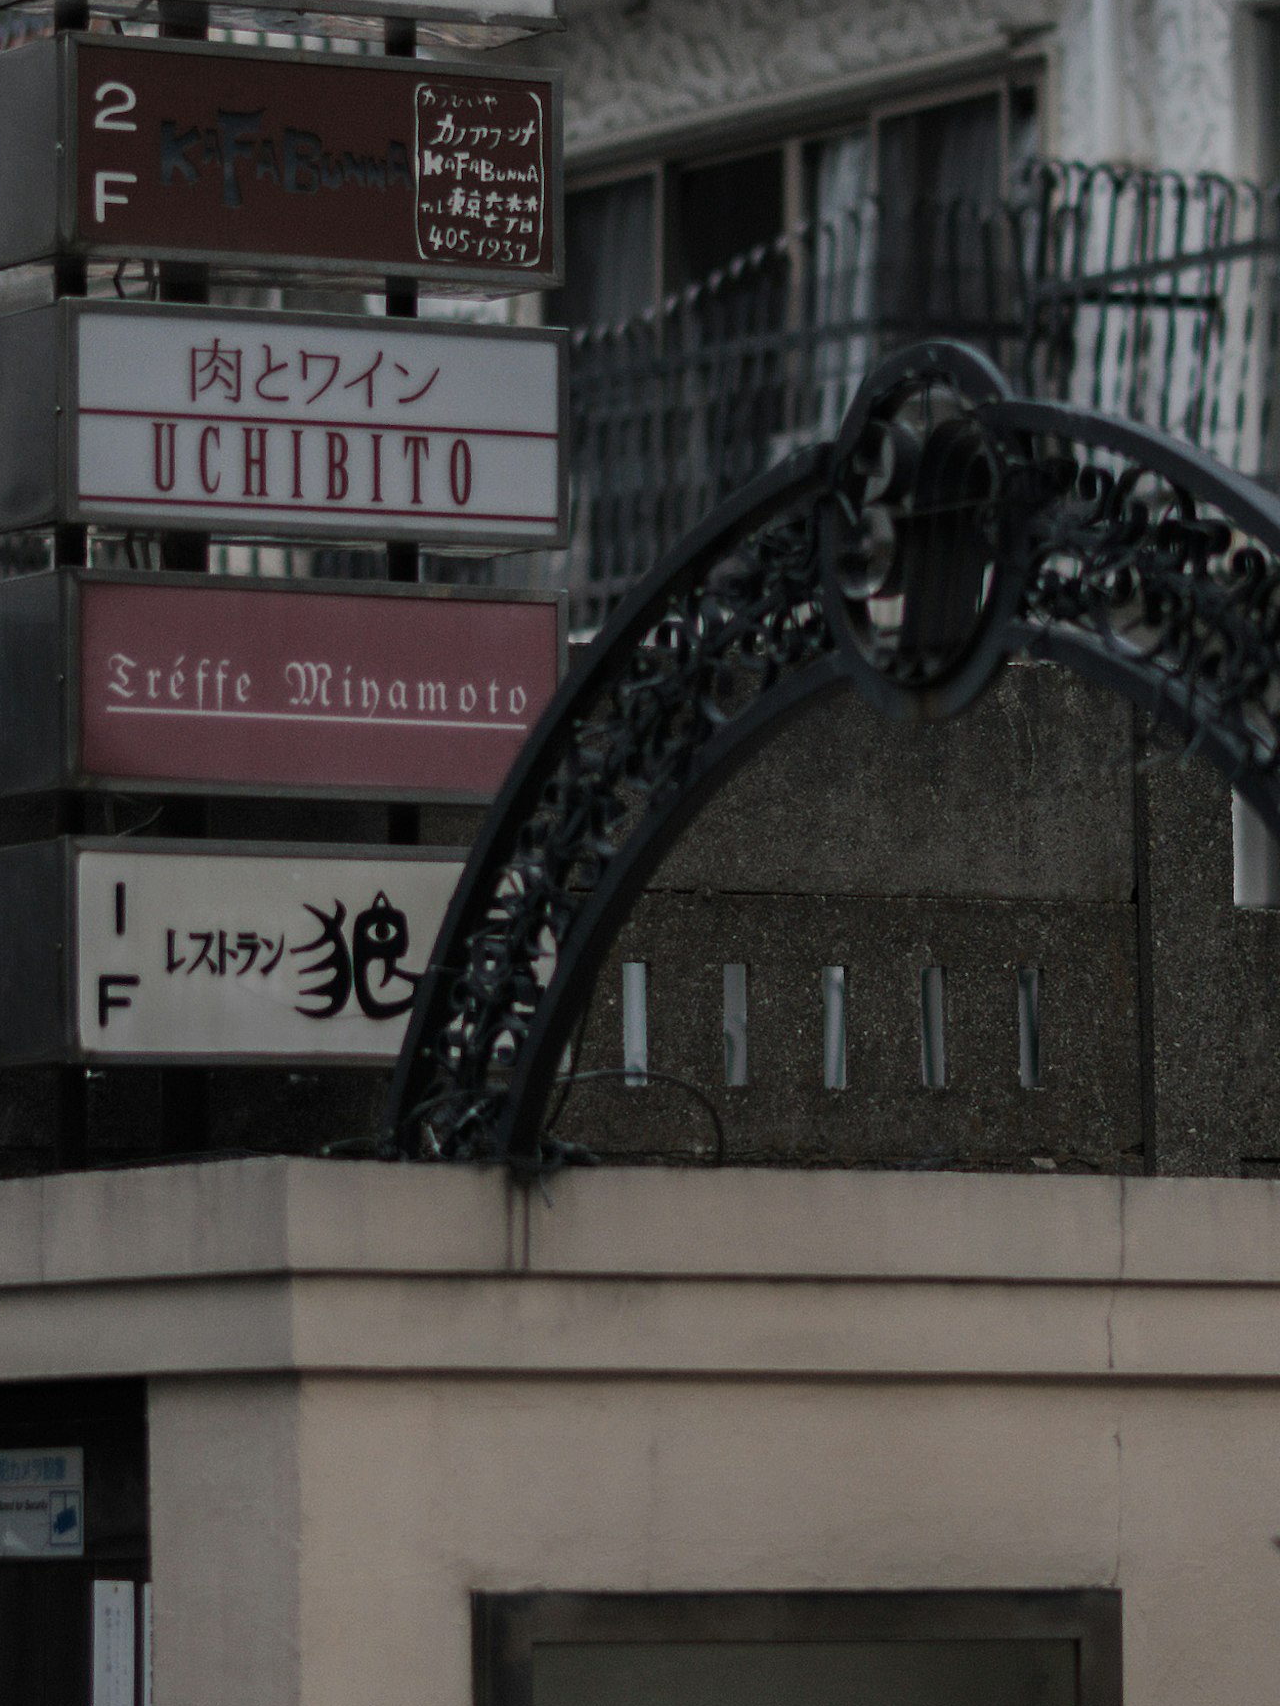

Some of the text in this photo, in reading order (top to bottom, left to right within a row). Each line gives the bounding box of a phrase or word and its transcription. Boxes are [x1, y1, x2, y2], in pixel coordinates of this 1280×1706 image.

[428, 224, 528, 262] 405-1937
[189, 337, 441, 410] 肉とワイン
[153, 422, 473, 506] UCHIBITO
[285, 660, 529, 719] Miyamoto
